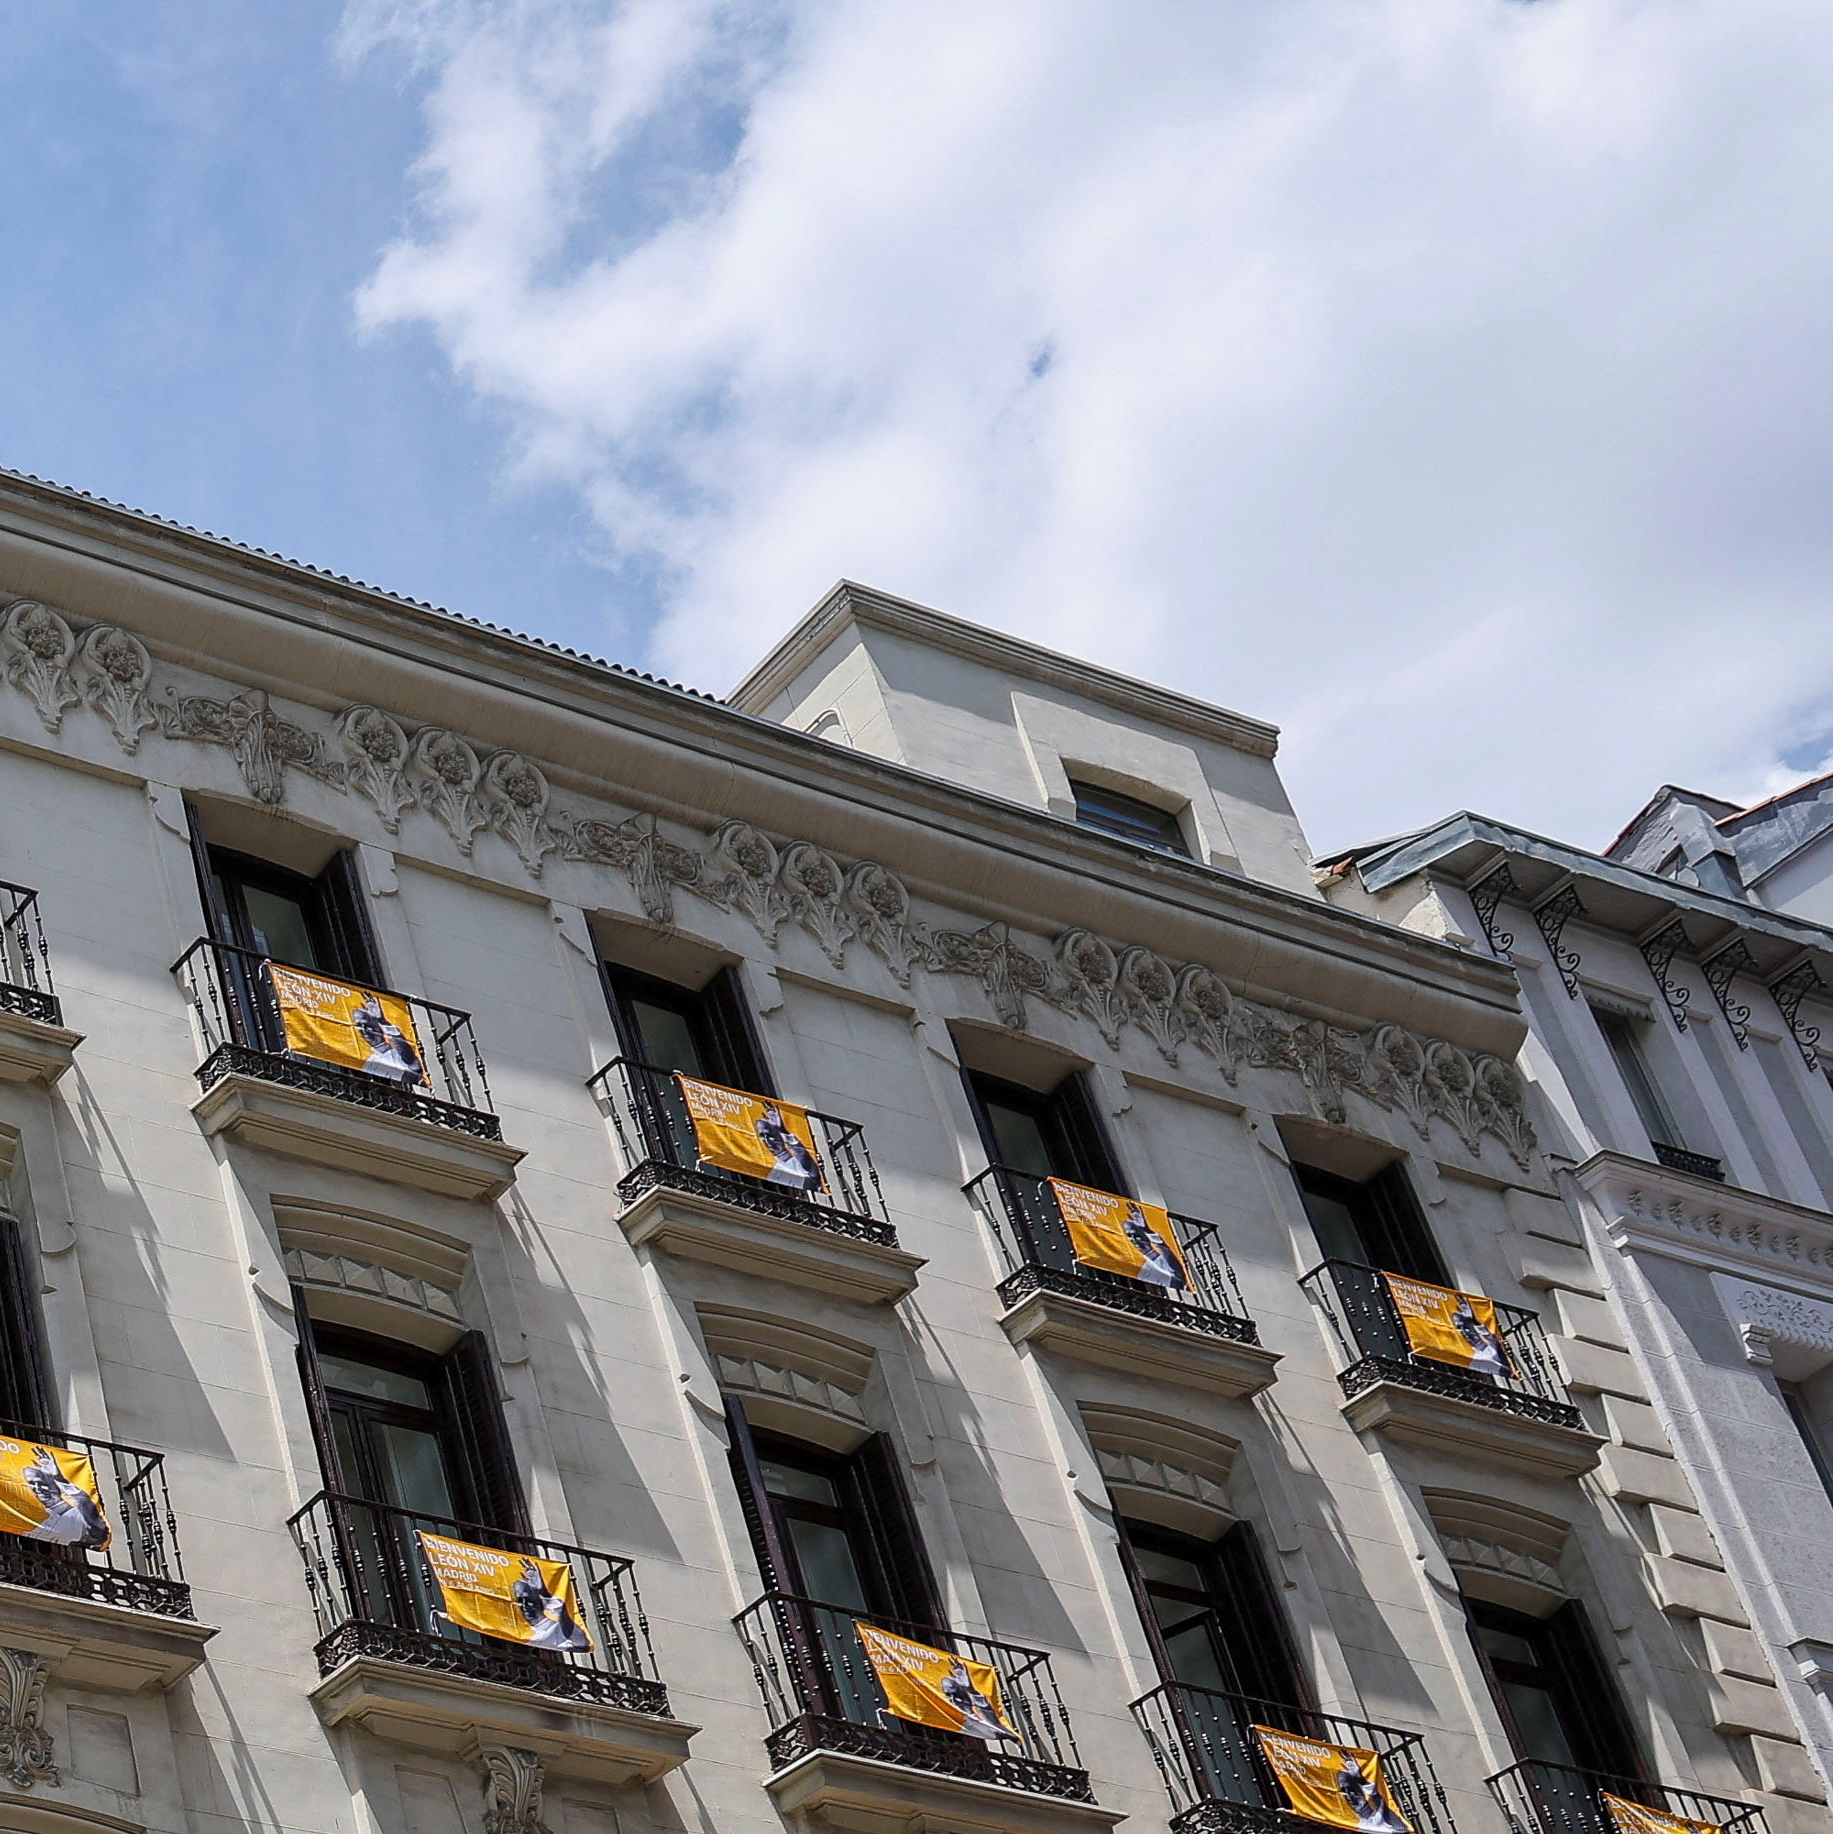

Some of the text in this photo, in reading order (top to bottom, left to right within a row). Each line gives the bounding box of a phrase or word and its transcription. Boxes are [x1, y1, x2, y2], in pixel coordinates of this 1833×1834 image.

[316, 988, 336, 1004] XIV
[425, 1540, 509, 1567] BIENVENIDO
[431, 1552, 494, 1576] LEÓN XIV
[435, 1566, 477, 1583] MADRID
